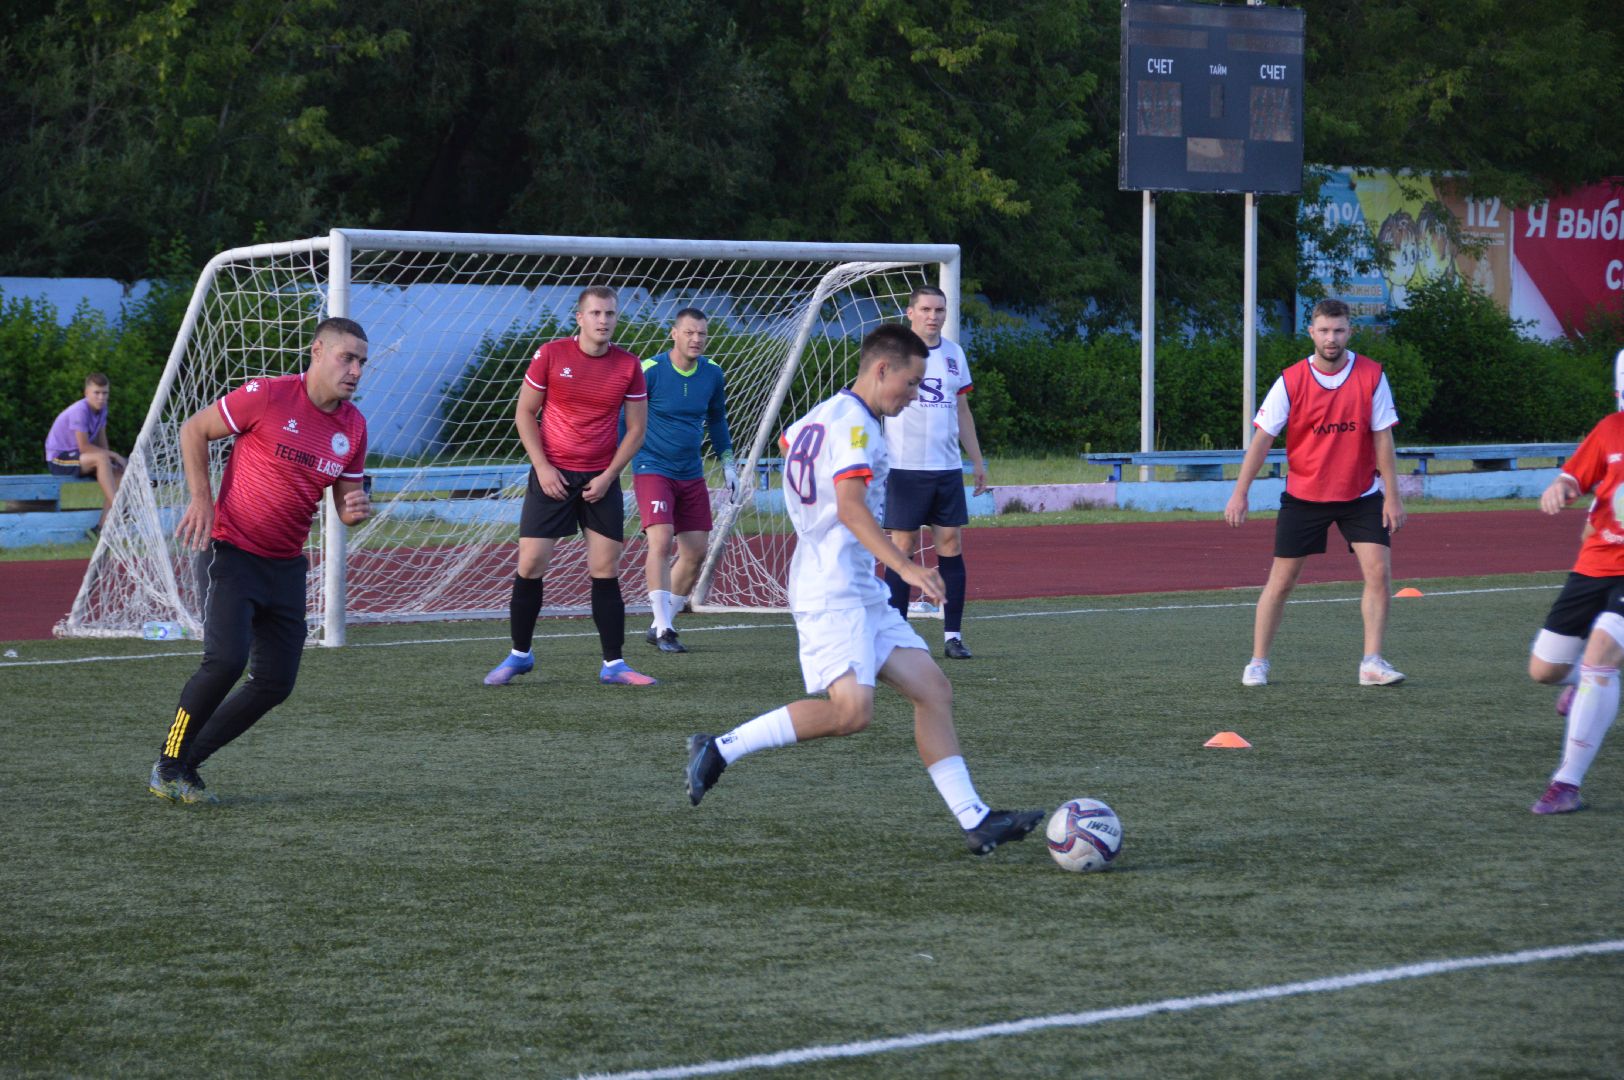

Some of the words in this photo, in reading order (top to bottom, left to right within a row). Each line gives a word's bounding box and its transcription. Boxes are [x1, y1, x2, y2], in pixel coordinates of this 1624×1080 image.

[1147, 58, 1174, 74] СЧЕТ
[1209, 64, 1227, 76] ТАЙМ
[1260, 64, 1287, 80] СЧЕТ
[1464, 193, 1500, 228] 112
[1525, 197, 1550, 238] Я
[1556, 199, 1624, 240] выб
[274, 443, 316, 468] TECHNO
[651, 500, 667, 513] 70
